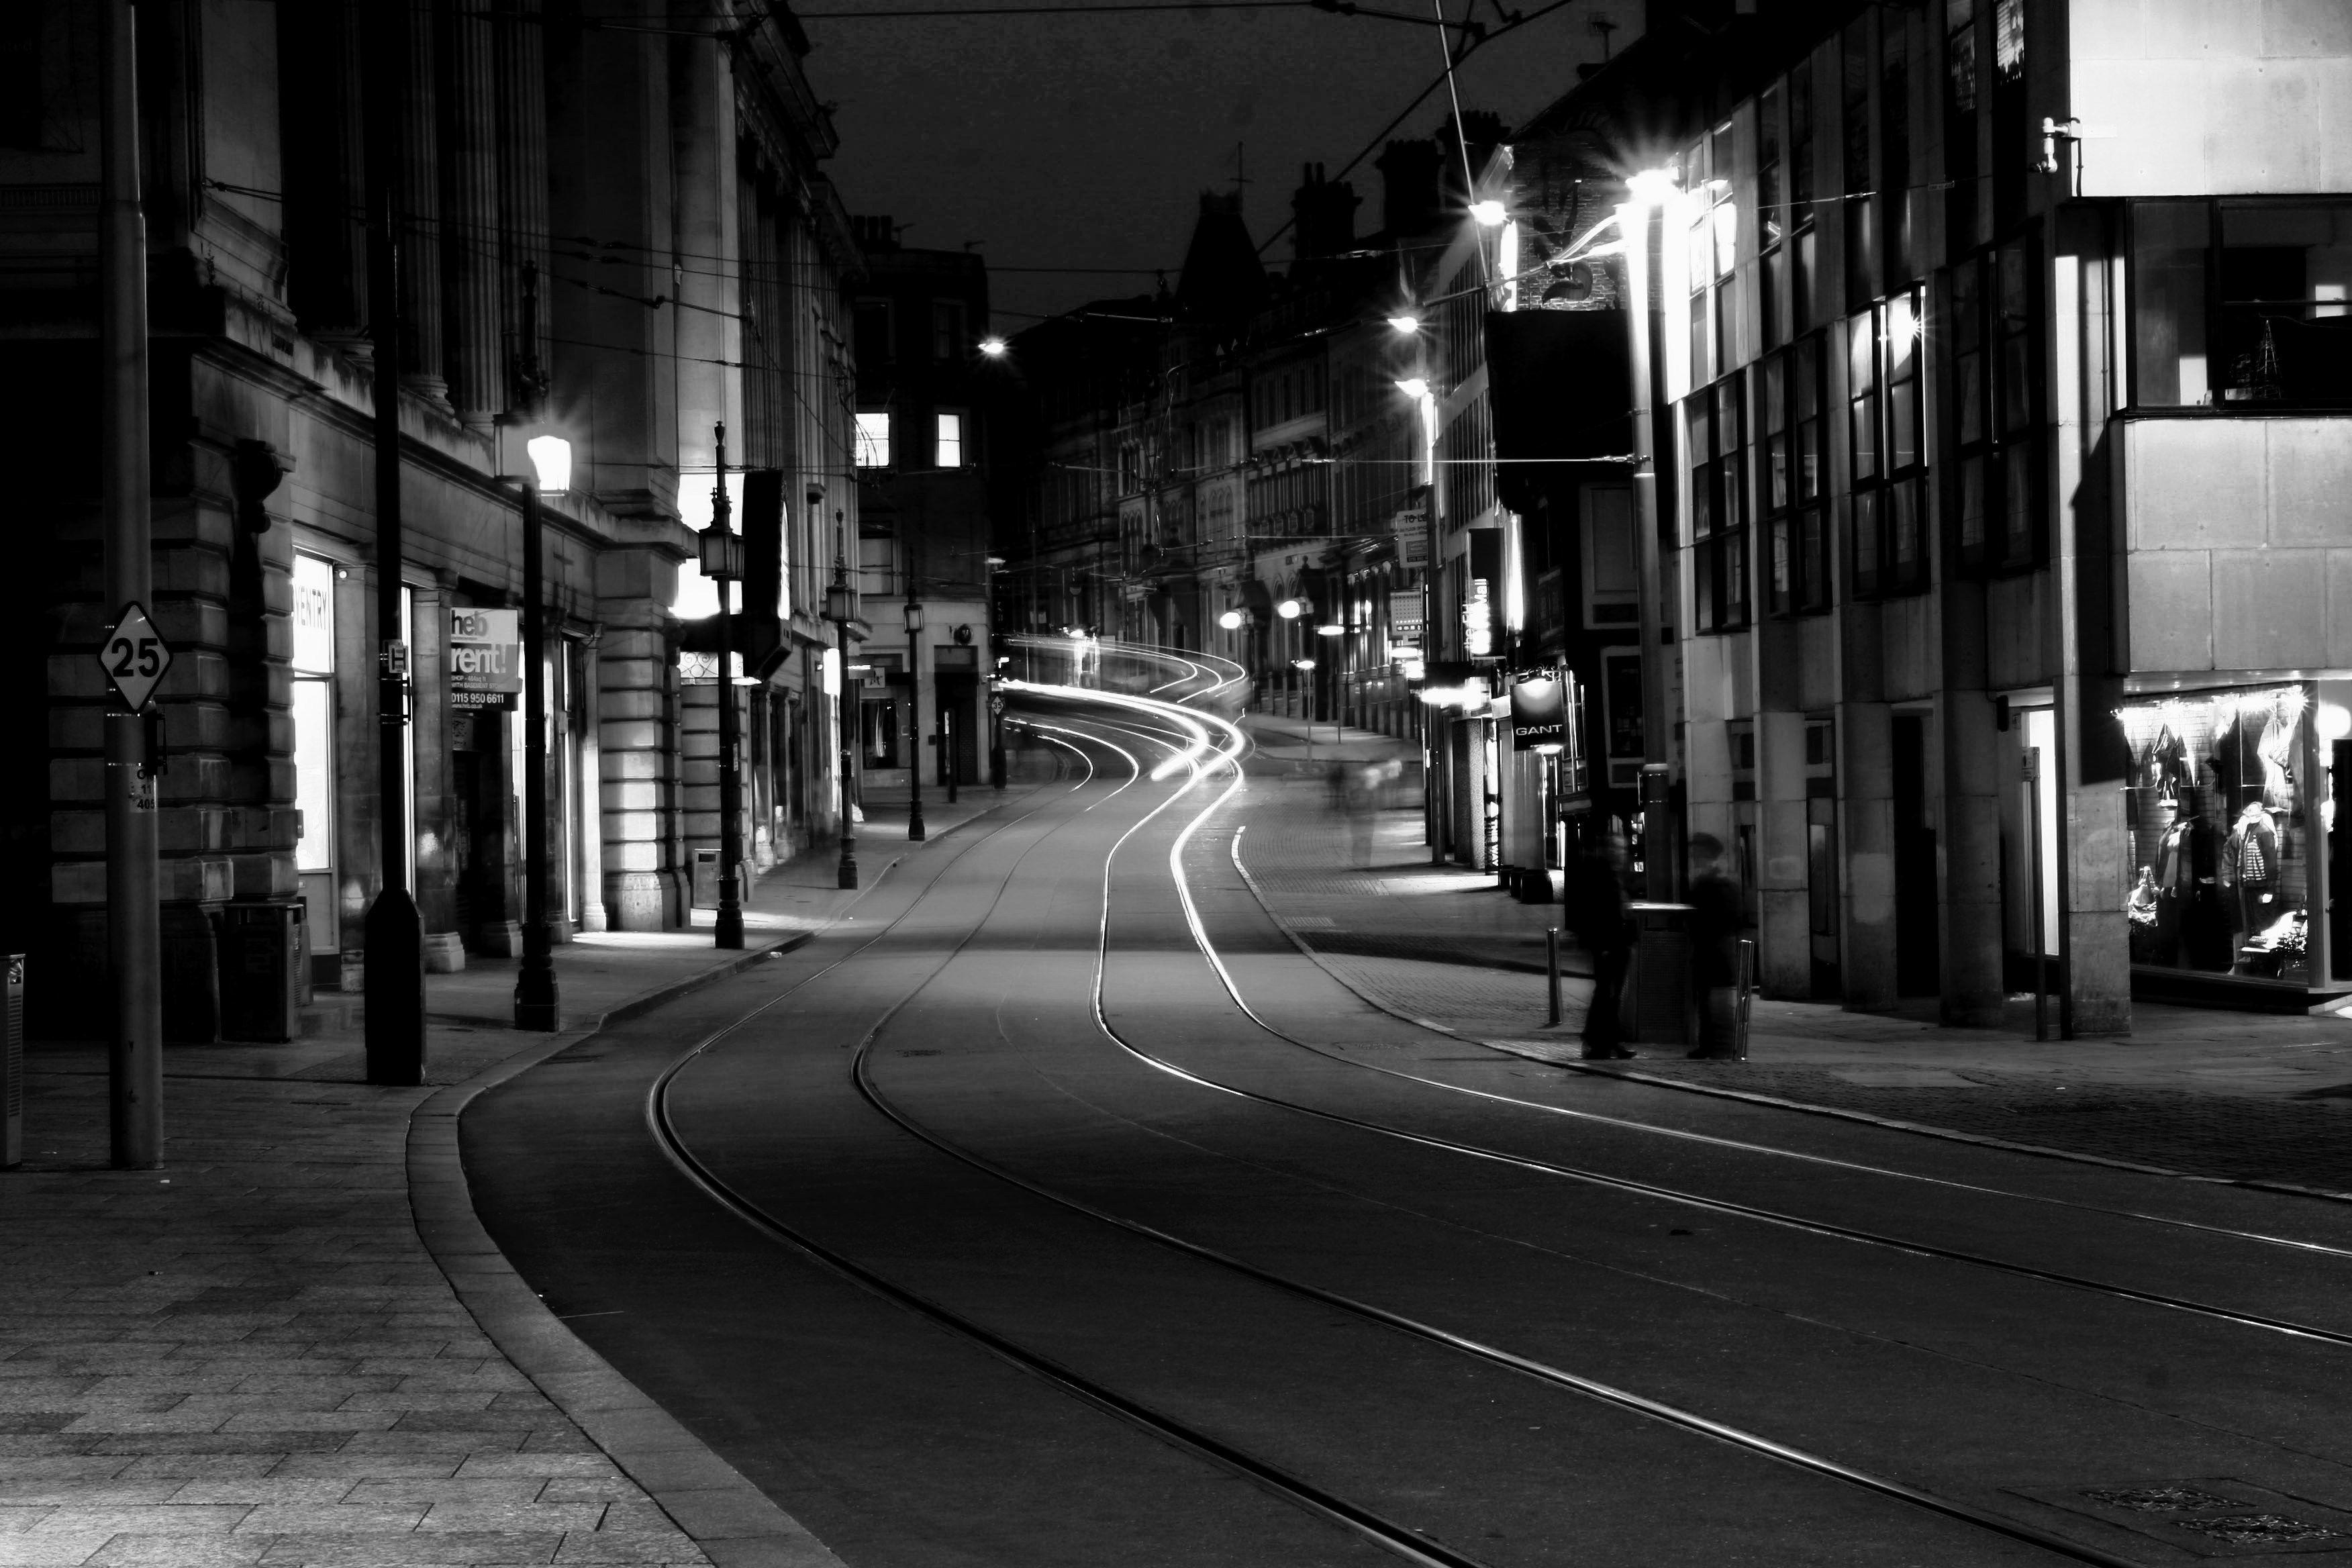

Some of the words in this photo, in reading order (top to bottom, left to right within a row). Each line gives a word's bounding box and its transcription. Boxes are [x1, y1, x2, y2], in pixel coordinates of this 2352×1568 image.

[1474, 579, 1487, 604] Mall
[451, 609, 487, 636] heb
[111, 638, 159, 677] 25
[451, 644, 506, 673] rent!
[452, 693, 469, 703] 0115
[471, 693, 485, 703] 950
[487, 693, 504, 703] 6611
[993, 701, 1002, 709] 35
[1516, 724, 1563, 736] GANT
